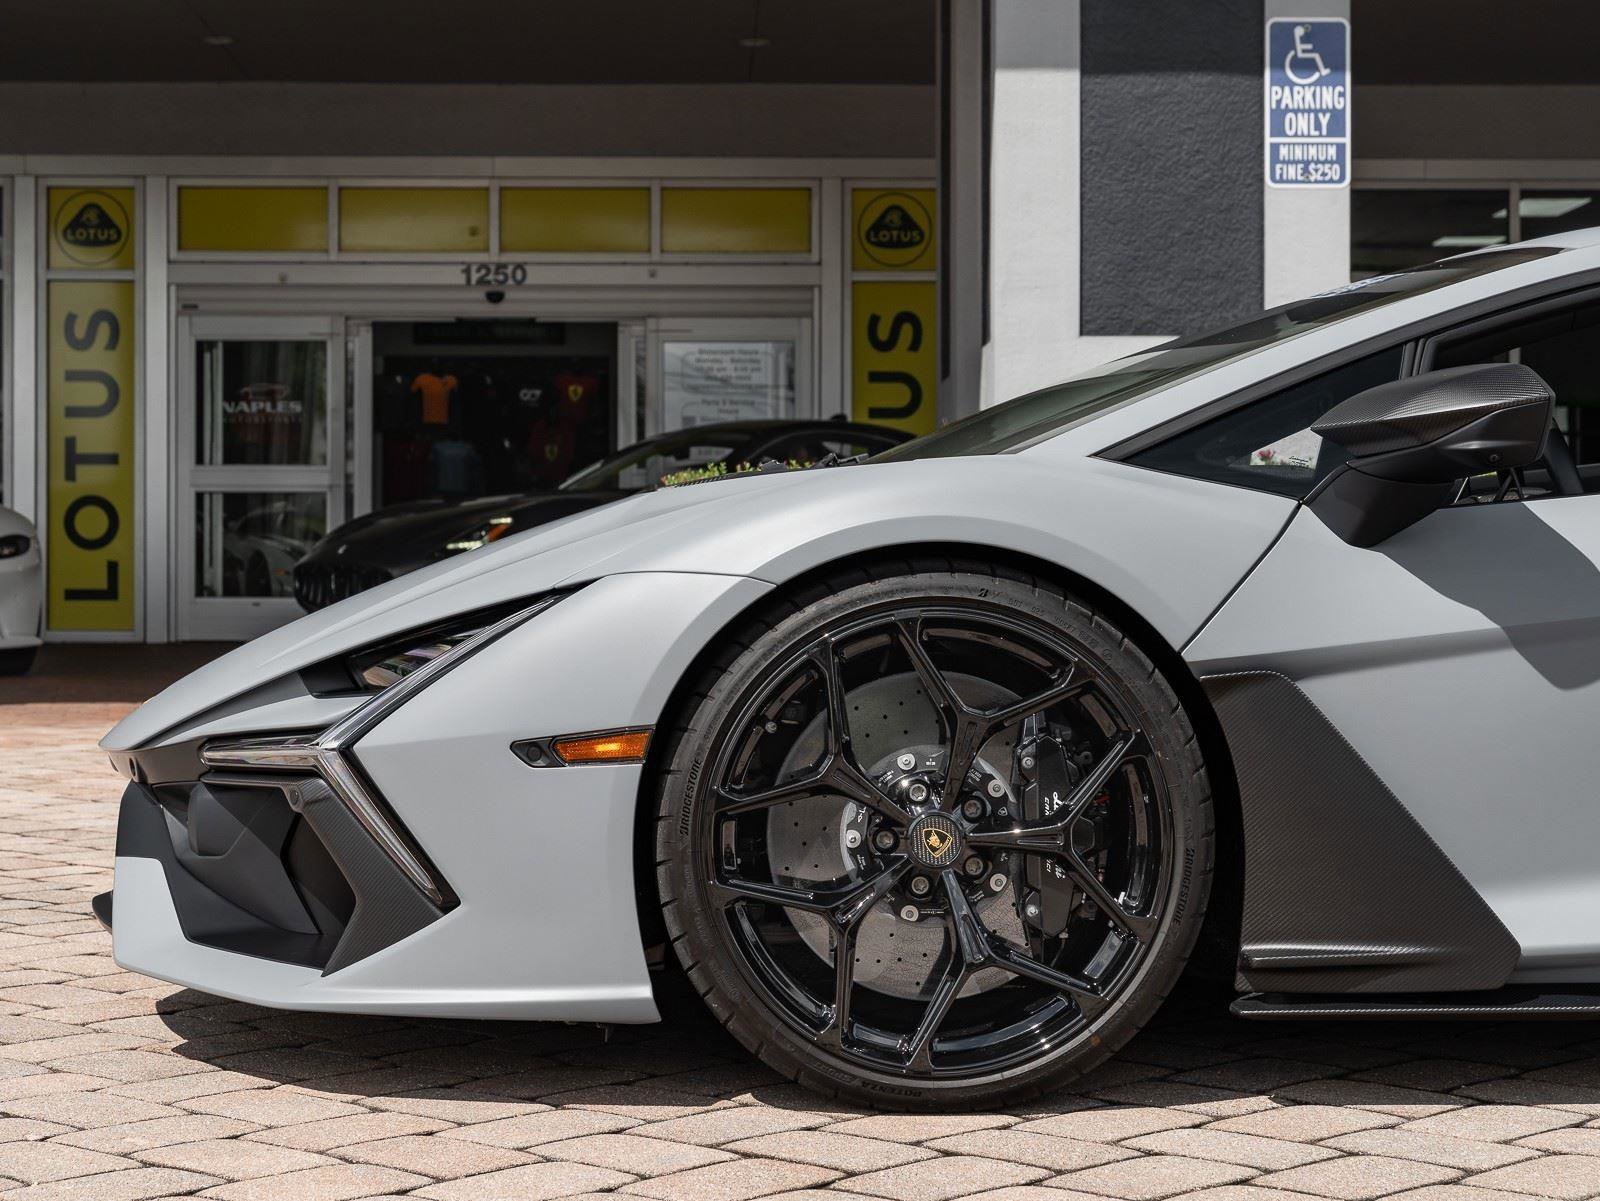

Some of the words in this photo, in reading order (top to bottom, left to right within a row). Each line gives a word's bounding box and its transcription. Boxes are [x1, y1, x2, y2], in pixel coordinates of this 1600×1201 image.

[1271, 85, 1345, 110] PARKING
[1284, 112, 1331, 136] ONLY
[1279, 144, 1336, 161] MINIMUM
[1275, 163, 1304, 180] FINE
[1309, 162, 1341, 182] $250
[66, 228, 118, 241] LOTUS
[869, 229, 921, 242] LOTUS
[461, 263, 527, 286] 1250
[868, 310, 922, 419] US
[64, 308, 119, 601] LOTUS
[679, 757, 701, 836] BRIDGESTONE
[1173, 847, 1195, 926] BRIDGESTONE
